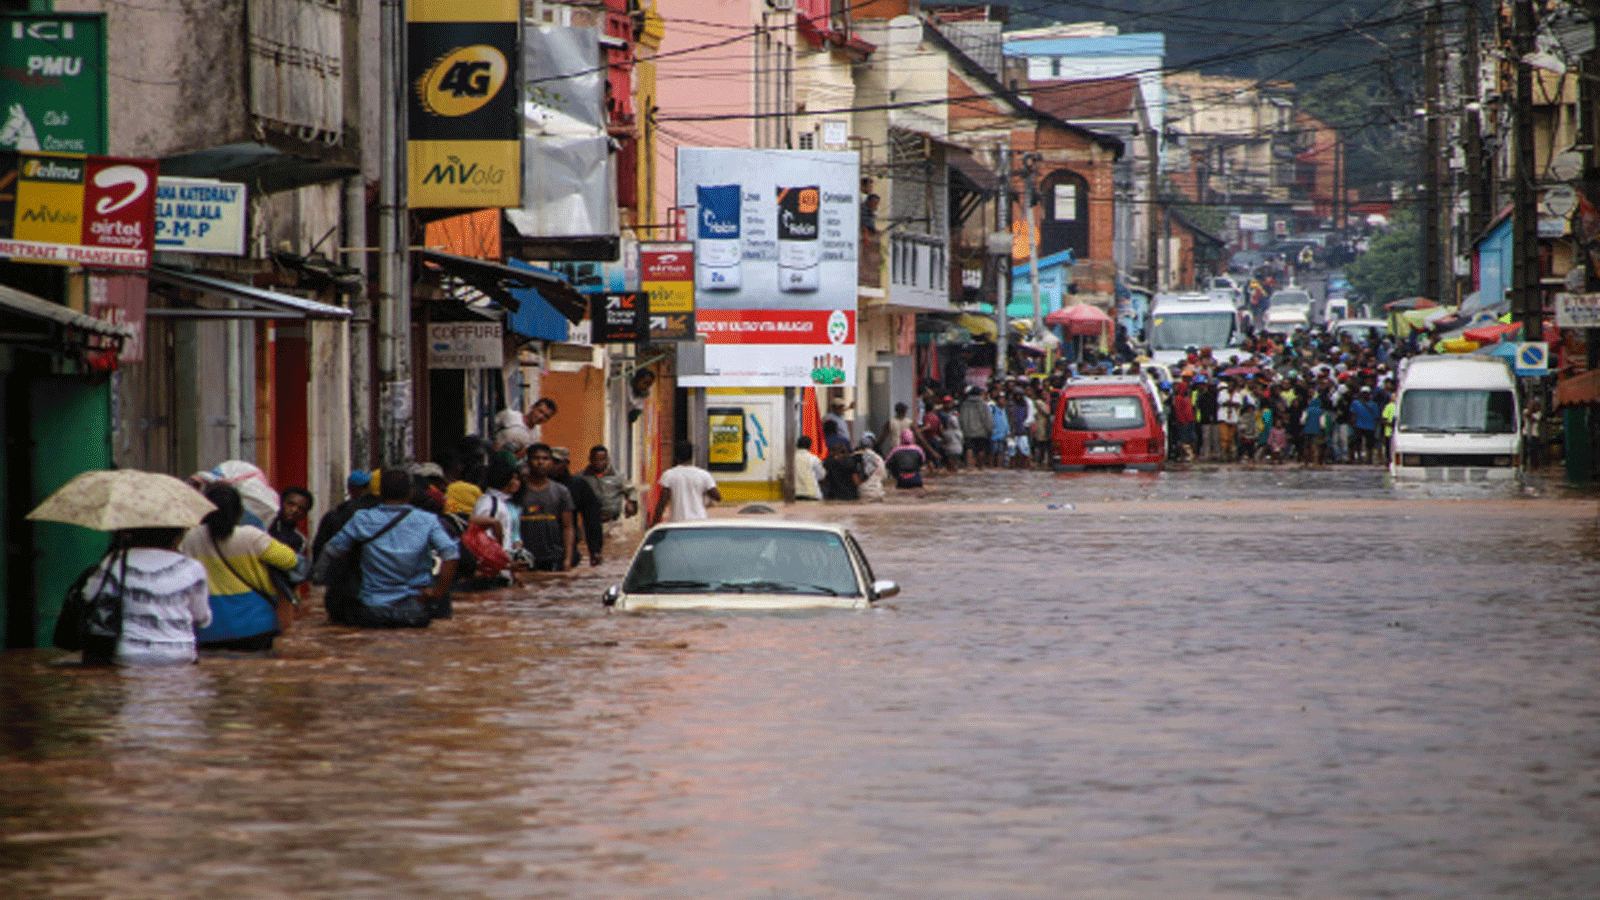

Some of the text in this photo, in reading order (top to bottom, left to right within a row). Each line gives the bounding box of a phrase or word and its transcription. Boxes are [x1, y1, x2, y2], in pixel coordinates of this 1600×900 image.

[12, 21, 74, 39] ICI
[27, 55, 82, 76] PMU
[438, 61, 491, 98] 4G
[24, 160, 80, 180] Telma
[177, 203, 222, 219] MALALA
[91, 219, 141, 236] airtel
[66, 248, 147, 267] TRANSFERT
[432, 325, 502, 339] COIFFURE
